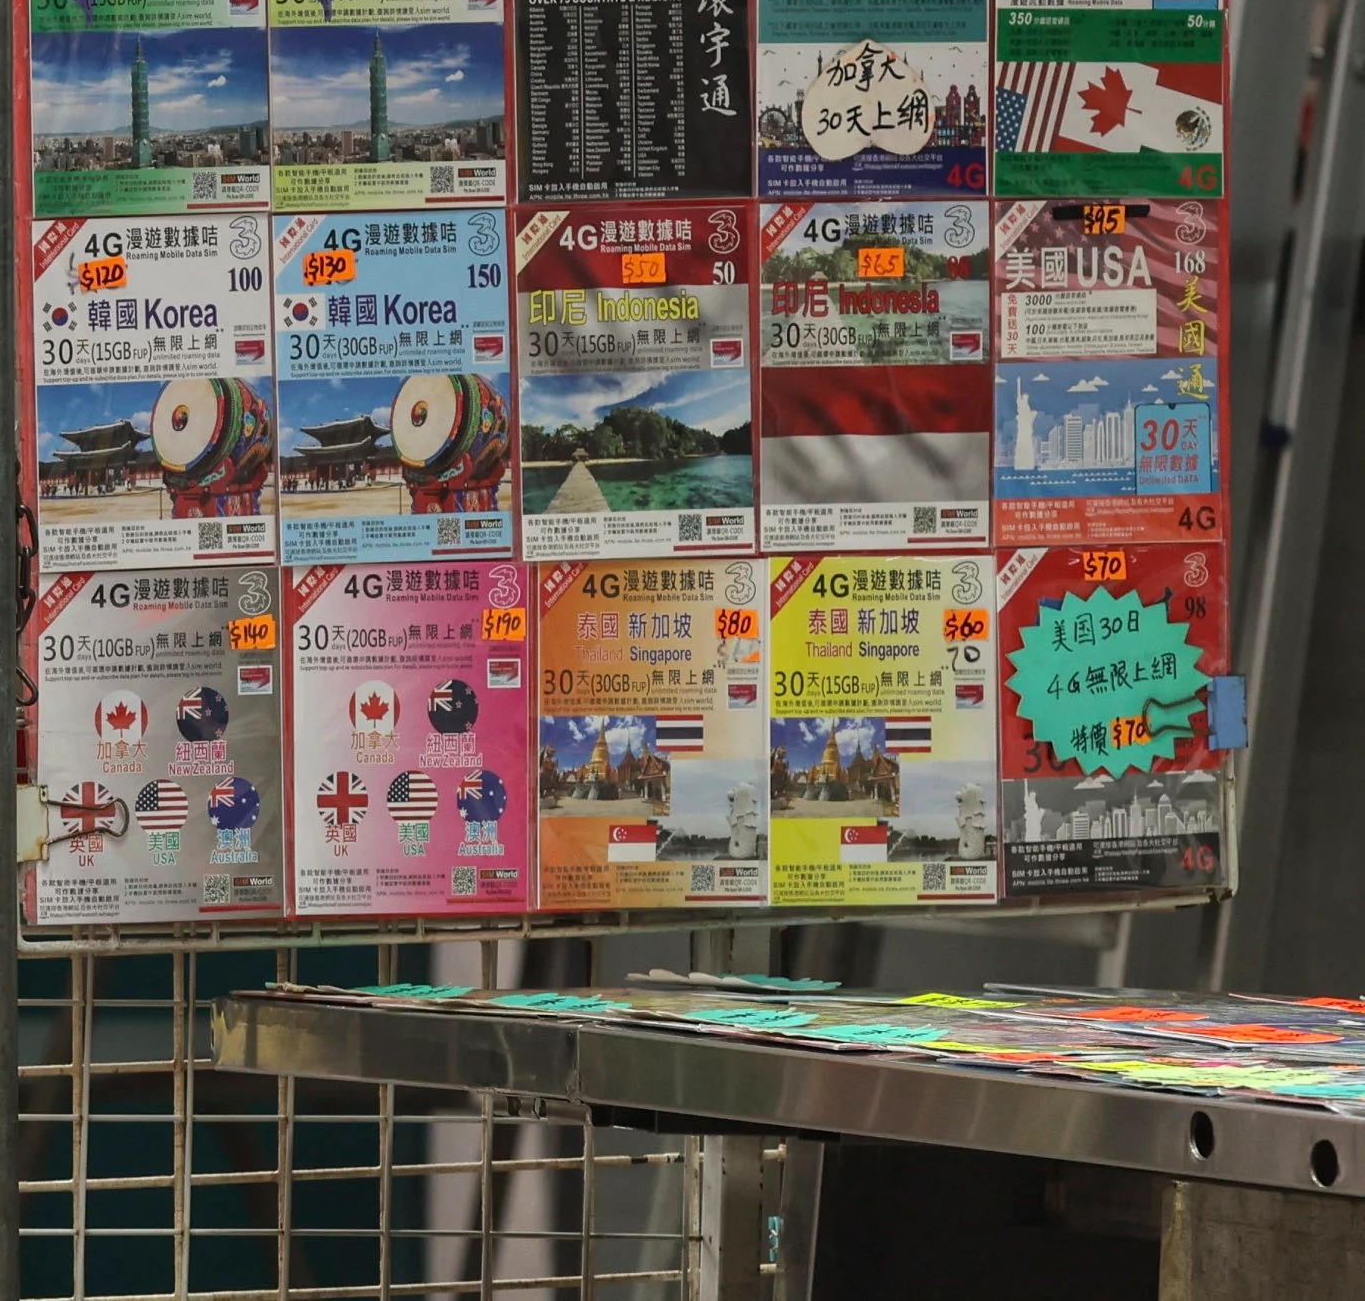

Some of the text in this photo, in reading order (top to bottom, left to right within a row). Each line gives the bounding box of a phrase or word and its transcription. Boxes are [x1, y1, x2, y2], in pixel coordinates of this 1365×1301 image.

[1005, 247, 1154, 289] 美國 USA
[1173, 250, 1206, 275] 168
[228, 268, 262, 293] 100
[88, 298, 218, 331] 韓國 Korea
[597, 290, 700, 323] Indonesia
[573, 642, 692, 665] Thailand Singapore
[102, 761, 142, 774] Canada
[209, 848, 259, 864] Australia
